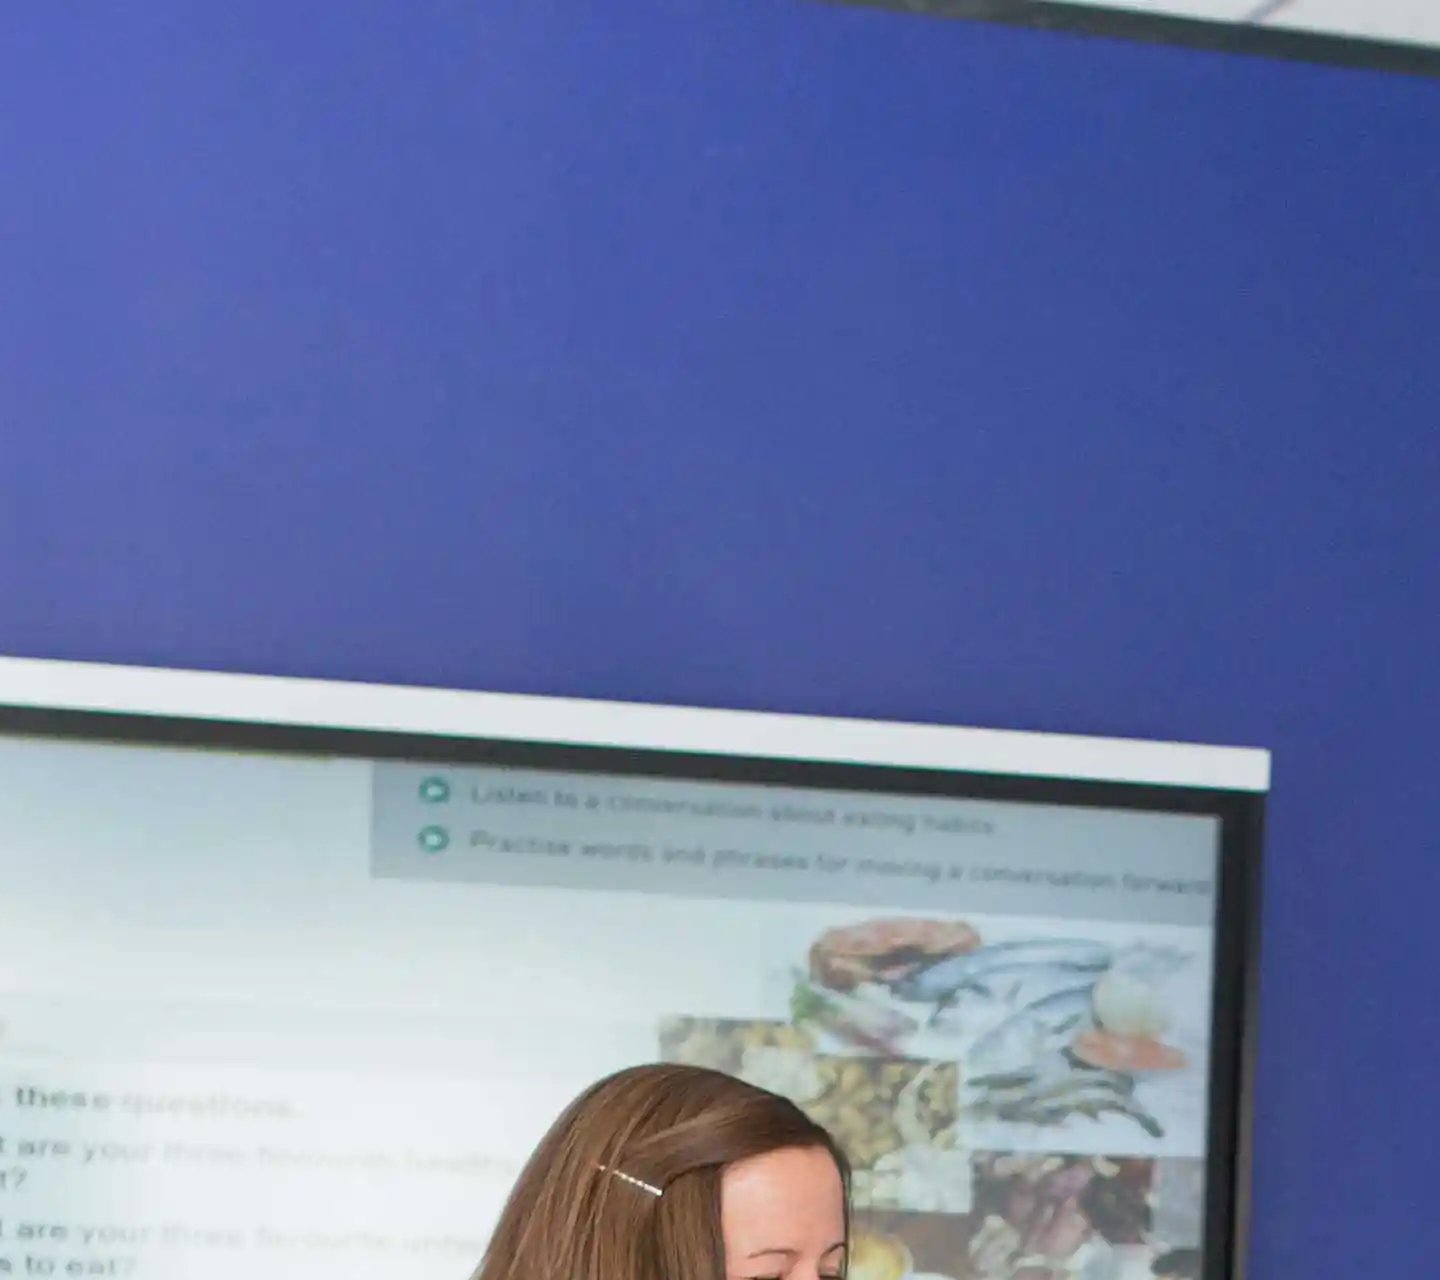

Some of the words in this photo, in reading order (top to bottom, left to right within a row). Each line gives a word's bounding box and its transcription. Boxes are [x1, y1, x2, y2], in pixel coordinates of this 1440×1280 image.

[553, 788, 578, 809] to
[661, 845, 706, 865] and
[817, 853, 848, 872] for
[14, 1084, 113, 1112] these
[17, 1137, 71, 1159] are
[79, 1140, 154, 1165] your
[16, 1222, 70, 1242] are
[77, 1223, 153, 1249] your
[24, 1252, 56, 1277] to
[64, 1254, 137, 1278] eat?
